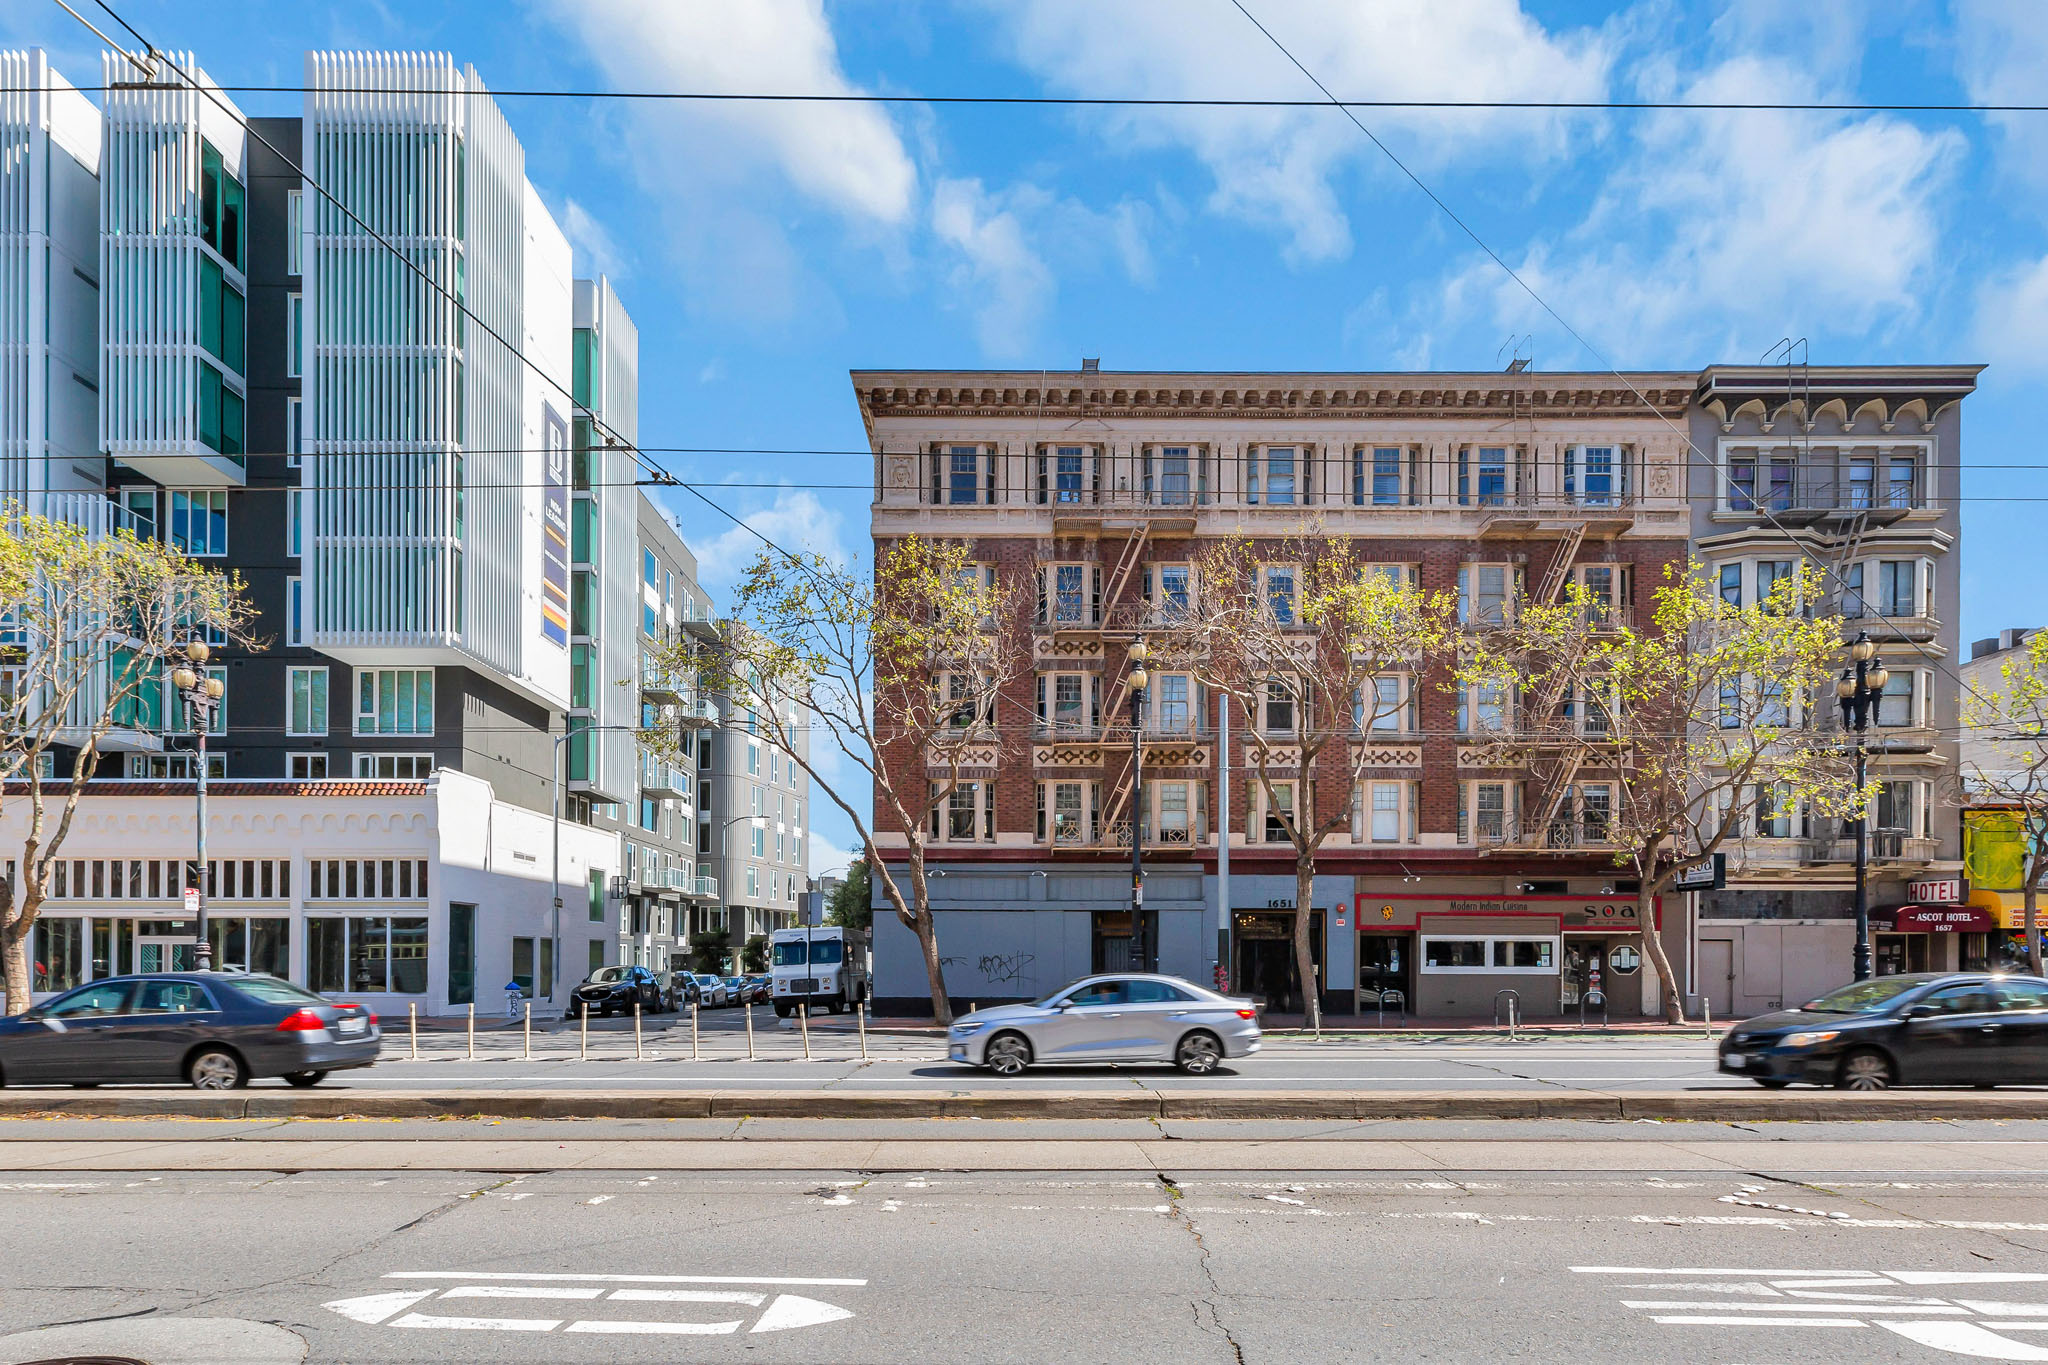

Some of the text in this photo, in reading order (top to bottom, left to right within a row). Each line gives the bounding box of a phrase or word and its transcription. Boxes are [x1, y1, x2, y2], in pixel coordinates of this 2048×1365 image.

[1909, 882, 1958, 901] HOTEL
[1267, 900, 1293, 908] 1651
[1450, 901, 1528, 911] Modern Indian Cuisine
[1916, 913, 1973, 922] ASCOT HOTEL
